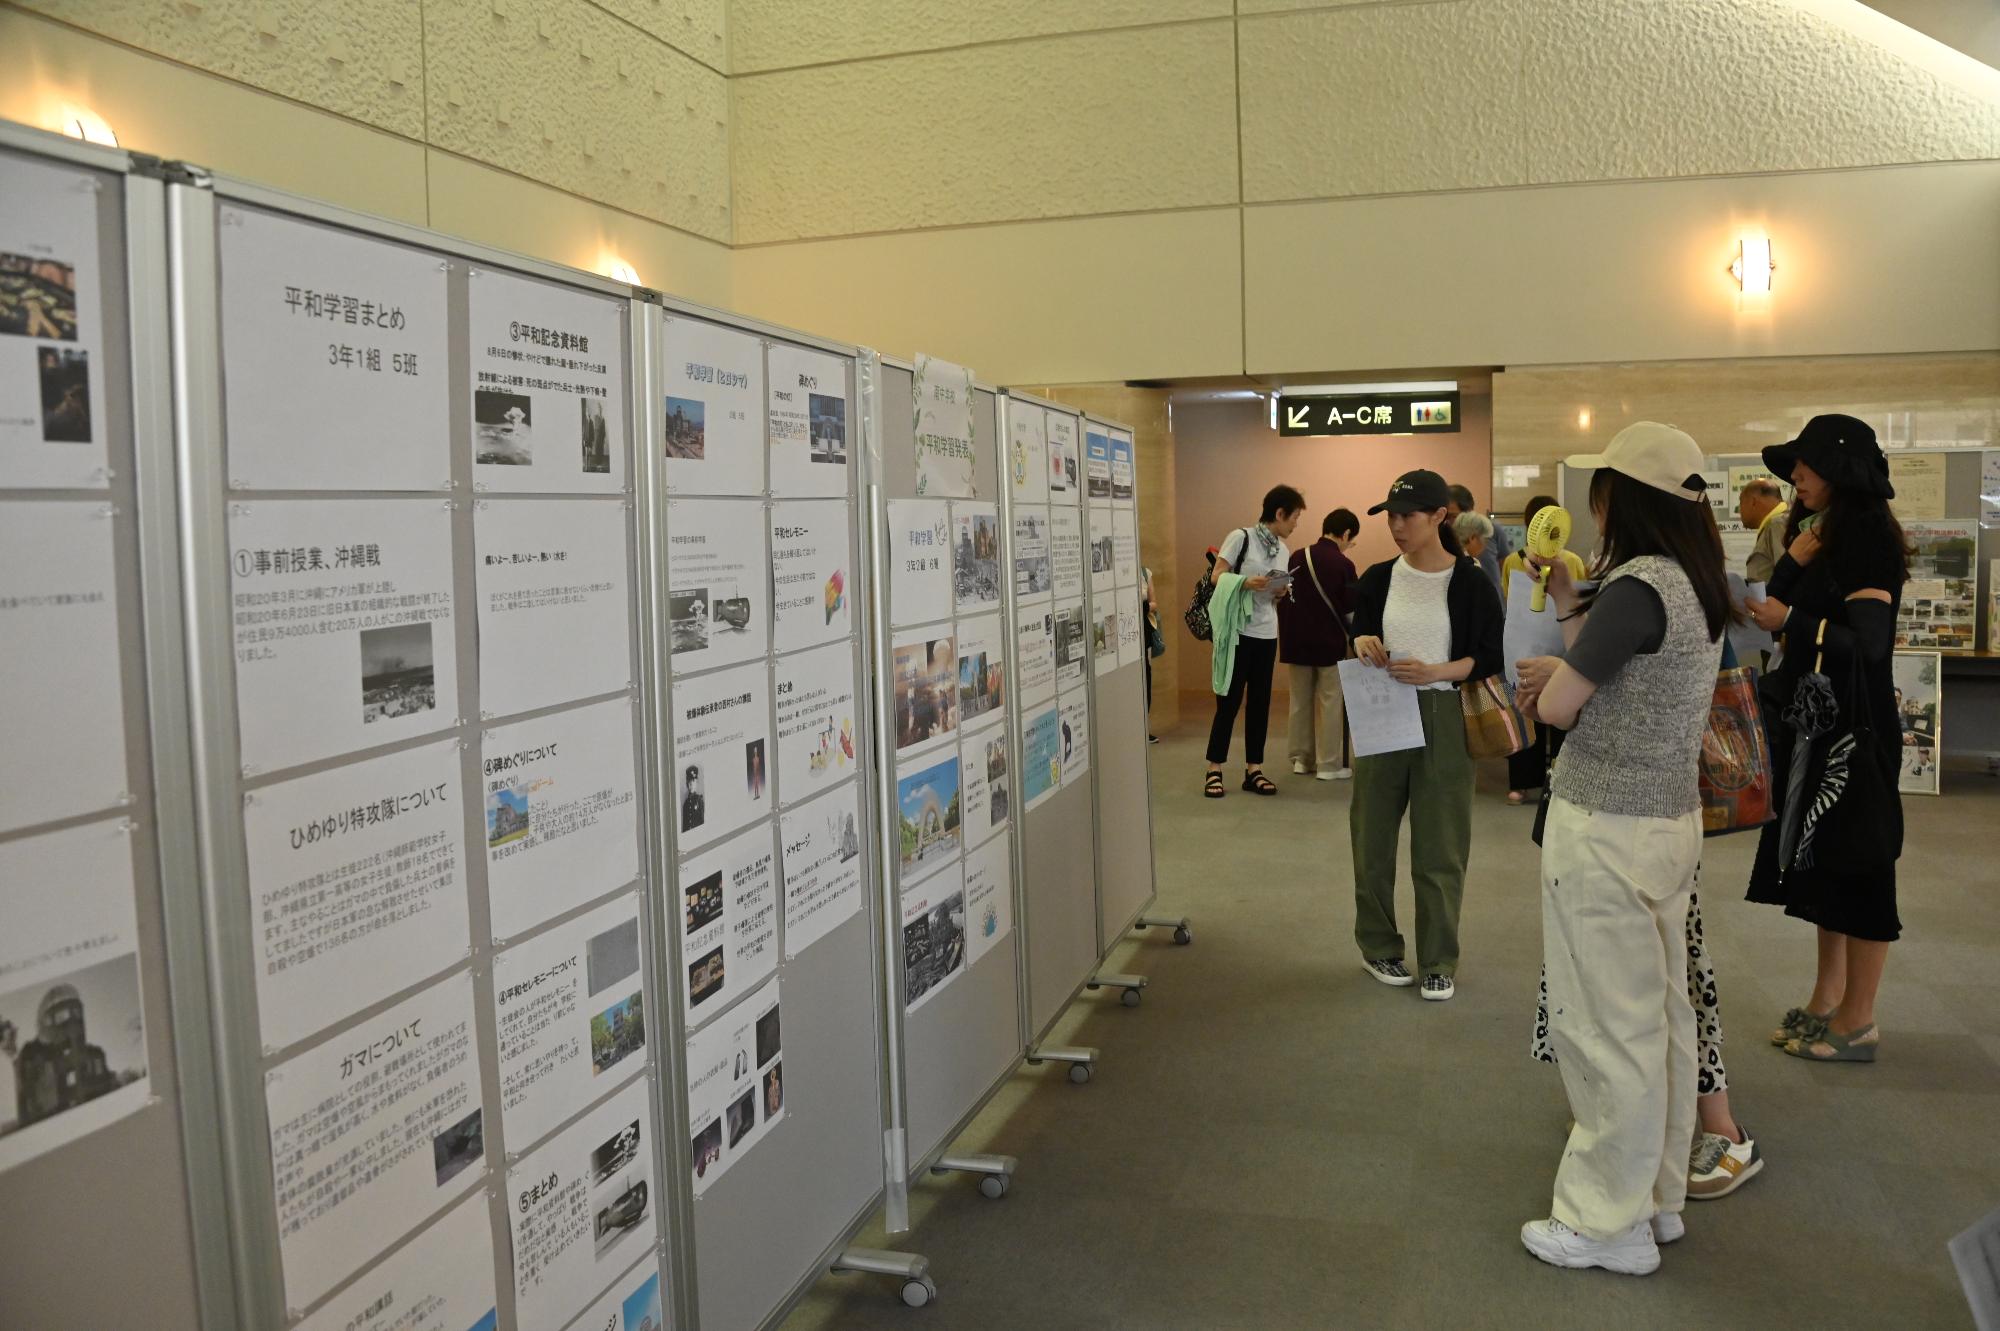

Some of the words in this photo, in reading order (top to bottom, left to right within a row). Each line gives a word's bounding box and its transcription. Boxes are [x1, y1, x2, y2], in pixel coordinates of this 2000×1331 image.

[285, 286, 405, 331] 平和学習まとめ
[509, 321, 588, 354] ③平和記念資料館
[328, 344, 381, 372] 3年1組
[393, 353, 418, 376] 5班
[233, 544, 381, 577] ①事前授業、沖縄戦
[483, 743, 558, 776] ④碑めぐりについて
[289, 783, 449, 850] ひめゆり特攻隊について
[498, 955, 576, 1005] ④平和セレモニーについて
[340, 1018, 421, 1080] ガマについて
[519, 1172, 558, 1213] ⑤まとめ
